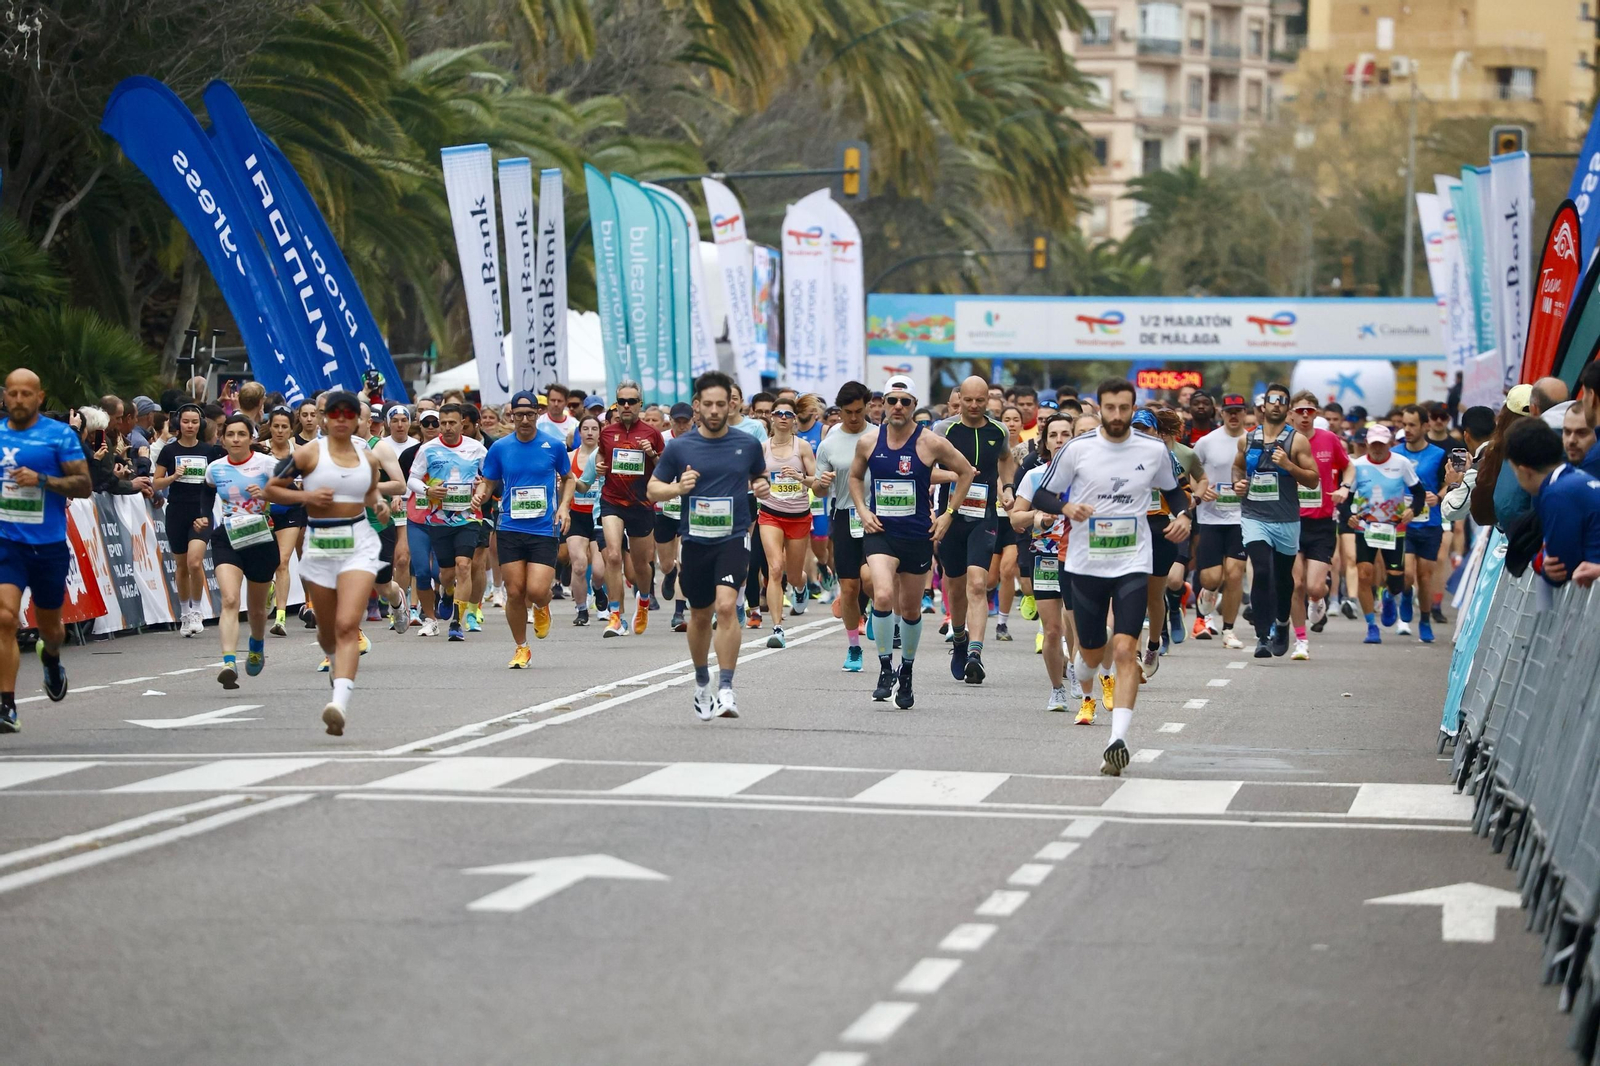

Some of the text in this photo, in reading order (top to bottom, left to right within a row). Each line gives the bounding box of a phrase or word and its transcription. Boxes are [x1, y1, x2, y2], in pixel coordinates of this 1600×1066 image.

[537, 219, 558, 386] CaixaBank
[1140, 314, 1232, 328] 1/2 MARATÓN
[1140, 332, 1220, 345] DE MÁLAGA
[778, 485, 798, 493] 3396
[519, 501, 542, 510] 4556
[884, 496, 908, 506] 4571
[699, 515, 726, 526] 3866
[318, 537, 347, 548] 6101
[1100, 536, 1130, 547] 4770
